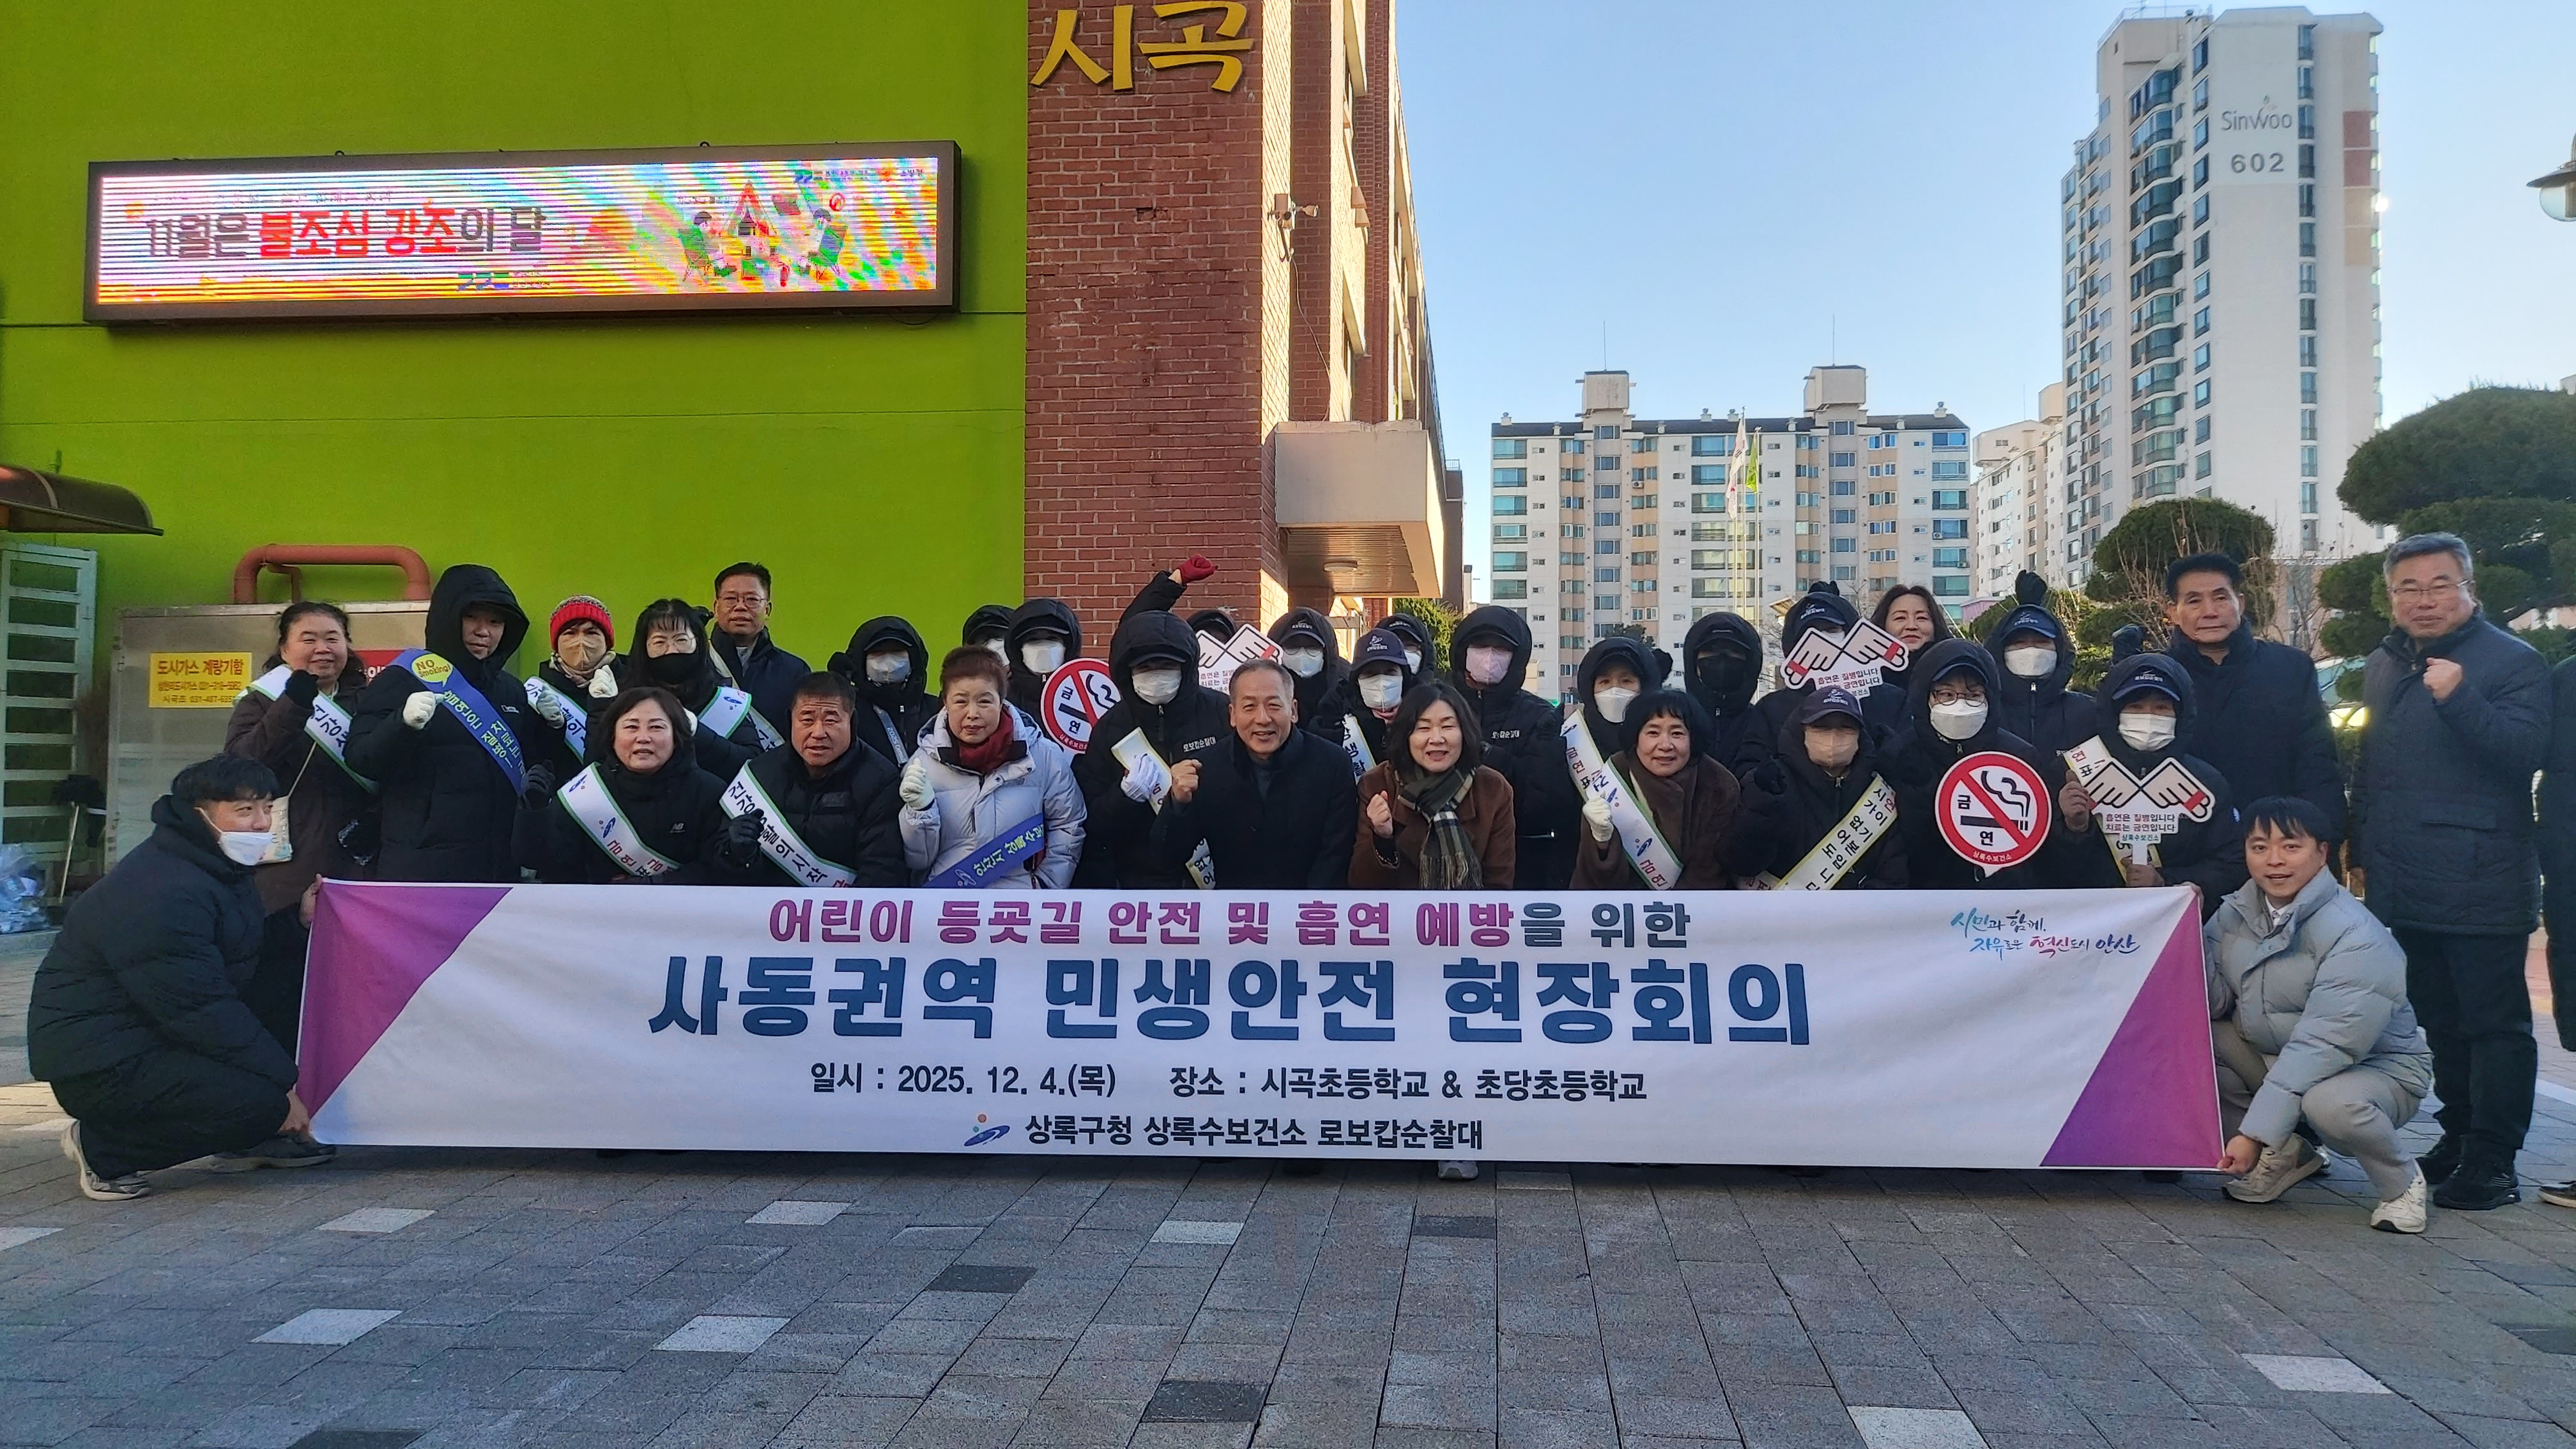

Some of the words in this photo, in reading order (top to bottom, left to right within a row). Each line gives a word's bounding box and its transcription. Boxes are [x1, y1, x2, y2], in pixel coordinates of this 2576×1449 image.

[1030, 1, 1254, 93] 시곡
[2230, 152, 2285, 174] 602
[147, 214, 250, 259] 11월은
[261, 211, 369, 259] 불조심
[385, 208, 494, 256] 강조의
[510, 206, 546, 252] 달
[157, 659, 199, 676] 도시가스
[202, 659, 244, 675] 계량기함
[415, 659, 435, 671] NO
[1818, 674, 1840, 685] 흡연은
[1841, 667, 1879, 680] 질병입니다
[1843, 676, 1880, 689] 금연입니다
[1061, 686, 1074, 701] 금
[1069, 720, 1082, 735] 연
[491, 720, 520, 758] 치료는
[1957, 794, 1971, 810] 금
[2106, 813, 2131, 822] 흡연은
[2133, 813, 2175, 822] 질병입니다
[2106, 824, 2131, 832] 치료는
[2133, 824, 2176, 832] 금연입니다
[1980, 831, 1993, 847] 연
[972, 848, 1006, 877] 안산시
[1973, 850, 2012, 862] 상록수보건소
[769, 899, 914, 944] 어린이
[937, 900, 1082, 944] 등굣길
[1108, 901, 1201, 945] 안전
[1228, 901, 1269, 946] 및
[1295, 900, 1390, 946] 흡연
[1416, 901, 1565, 947] 예방을
[1590, 901, 1691, 949] 위한
[1950, 907, 2005, 939] 시민과
[1970, 937, 2024, 961] 자유로운
[2029, 935, 2090, 959] 혁신도시
[2095, 933, 2140, 954] 안산
[648, 955, 997, 1039] 사동권역
[1045, 958, 1395, 1043] 민생안전
[1443, 957, 1810, 1046] 현장회의
[811, 1062, 862, 1093] 일시
[877, 1068, 884, 1089] :
[898, 1065, 973, 1094] 2025.
[987, 1066, 1027, 1095] 12.
[1039, 1063, 1116, 1098] 4.(목)
[1169, 1066, 1225, 1098] 장소
[1239, 1071, 1246, 1094] :
[1261, 1067, 1430, 1100] 시곡초등학교
[1441, 1070, 1463, 1098] &
[1475, 1069, 1647, 1102] 초당초등학교
[1025, 1115, 1132, 1146] 상록구청
[1143, 1116, 1307, 1147] 상록수보건소
[1317, 1119, 1482, 1150] 로보캅순찰대
